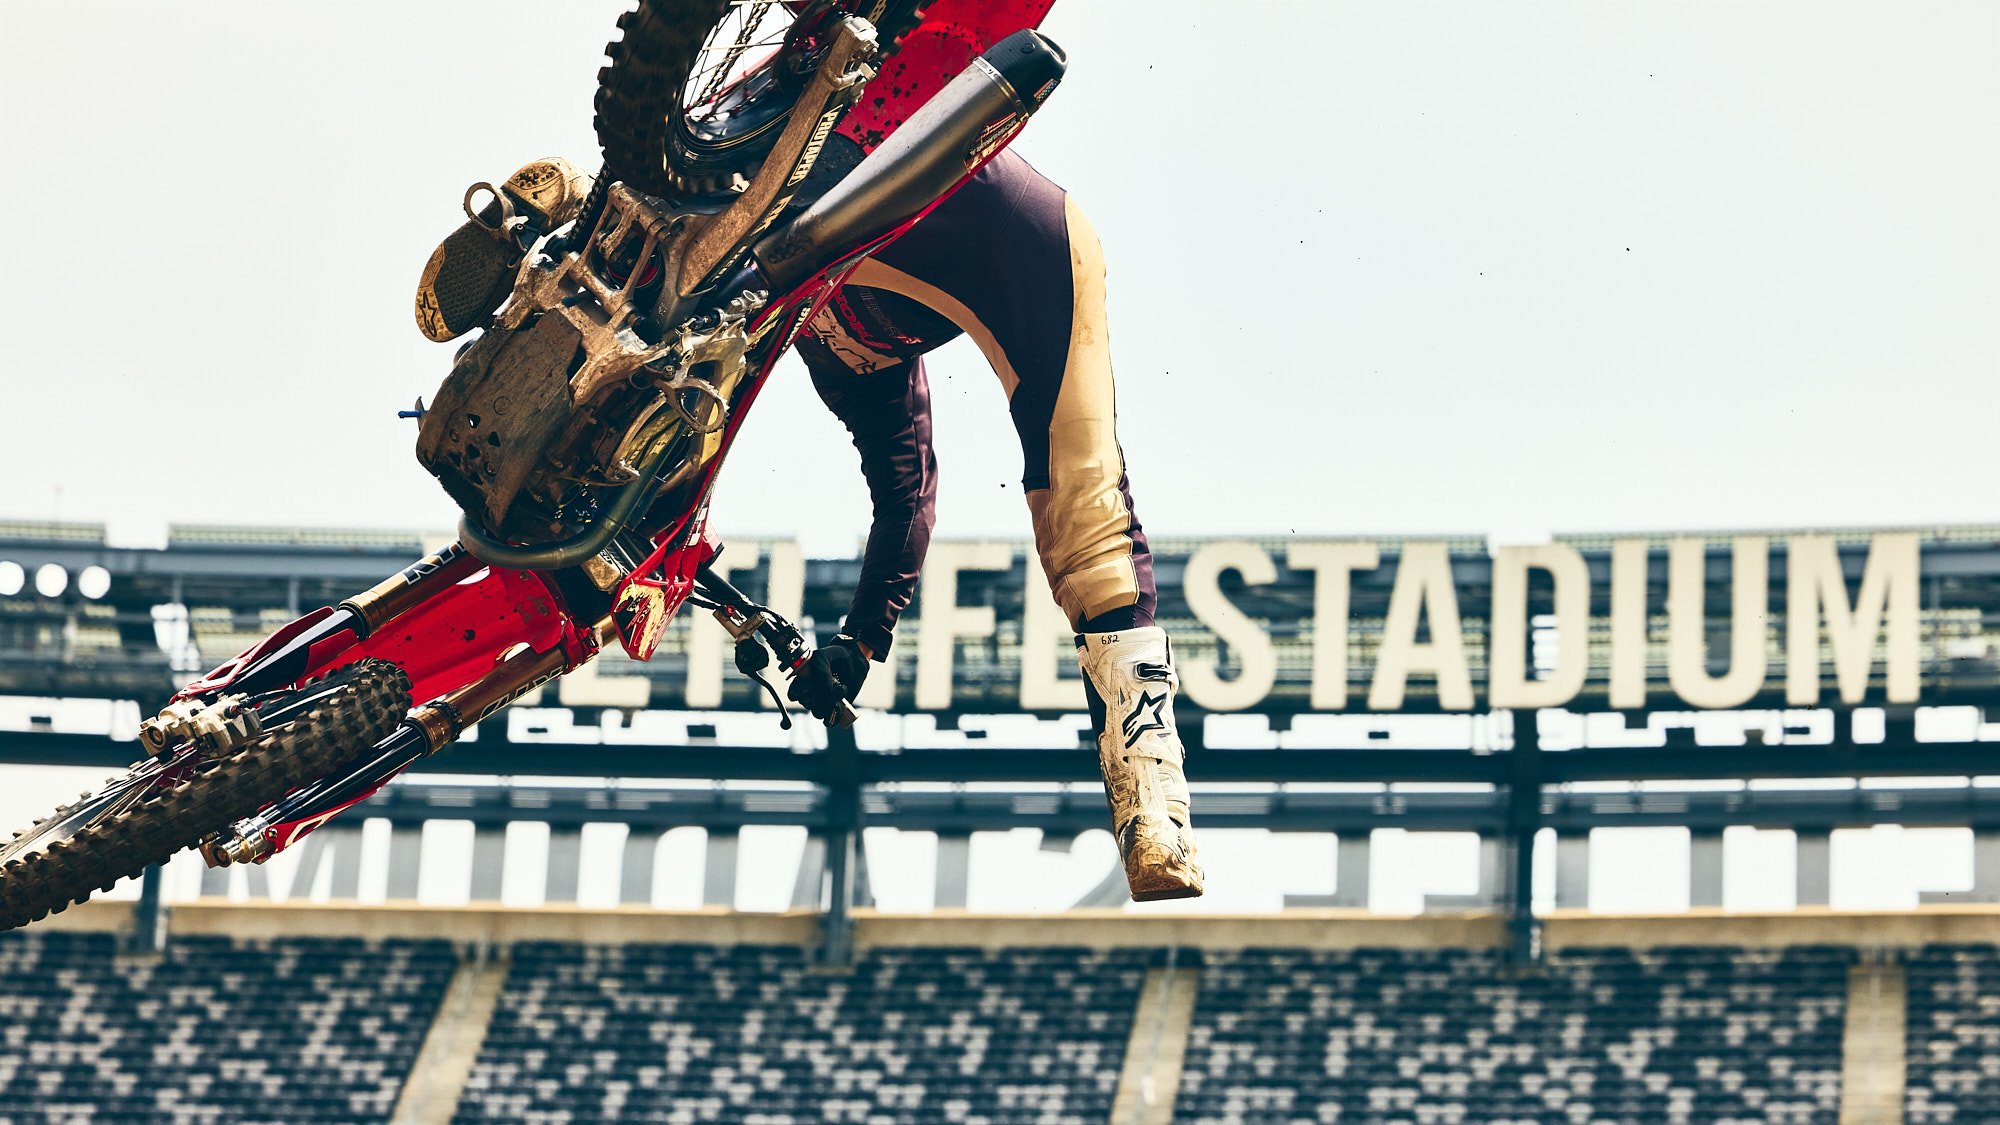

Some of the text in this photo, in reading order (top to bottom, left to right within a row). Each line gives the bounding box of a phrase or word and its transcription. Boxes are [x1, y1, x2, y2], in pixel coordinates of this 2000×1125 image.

[791, 109, 840, 182] PROTAPER
[1101, 634, 1120, 645] 682
[1179, 534, 1921, 711] STADIUM
